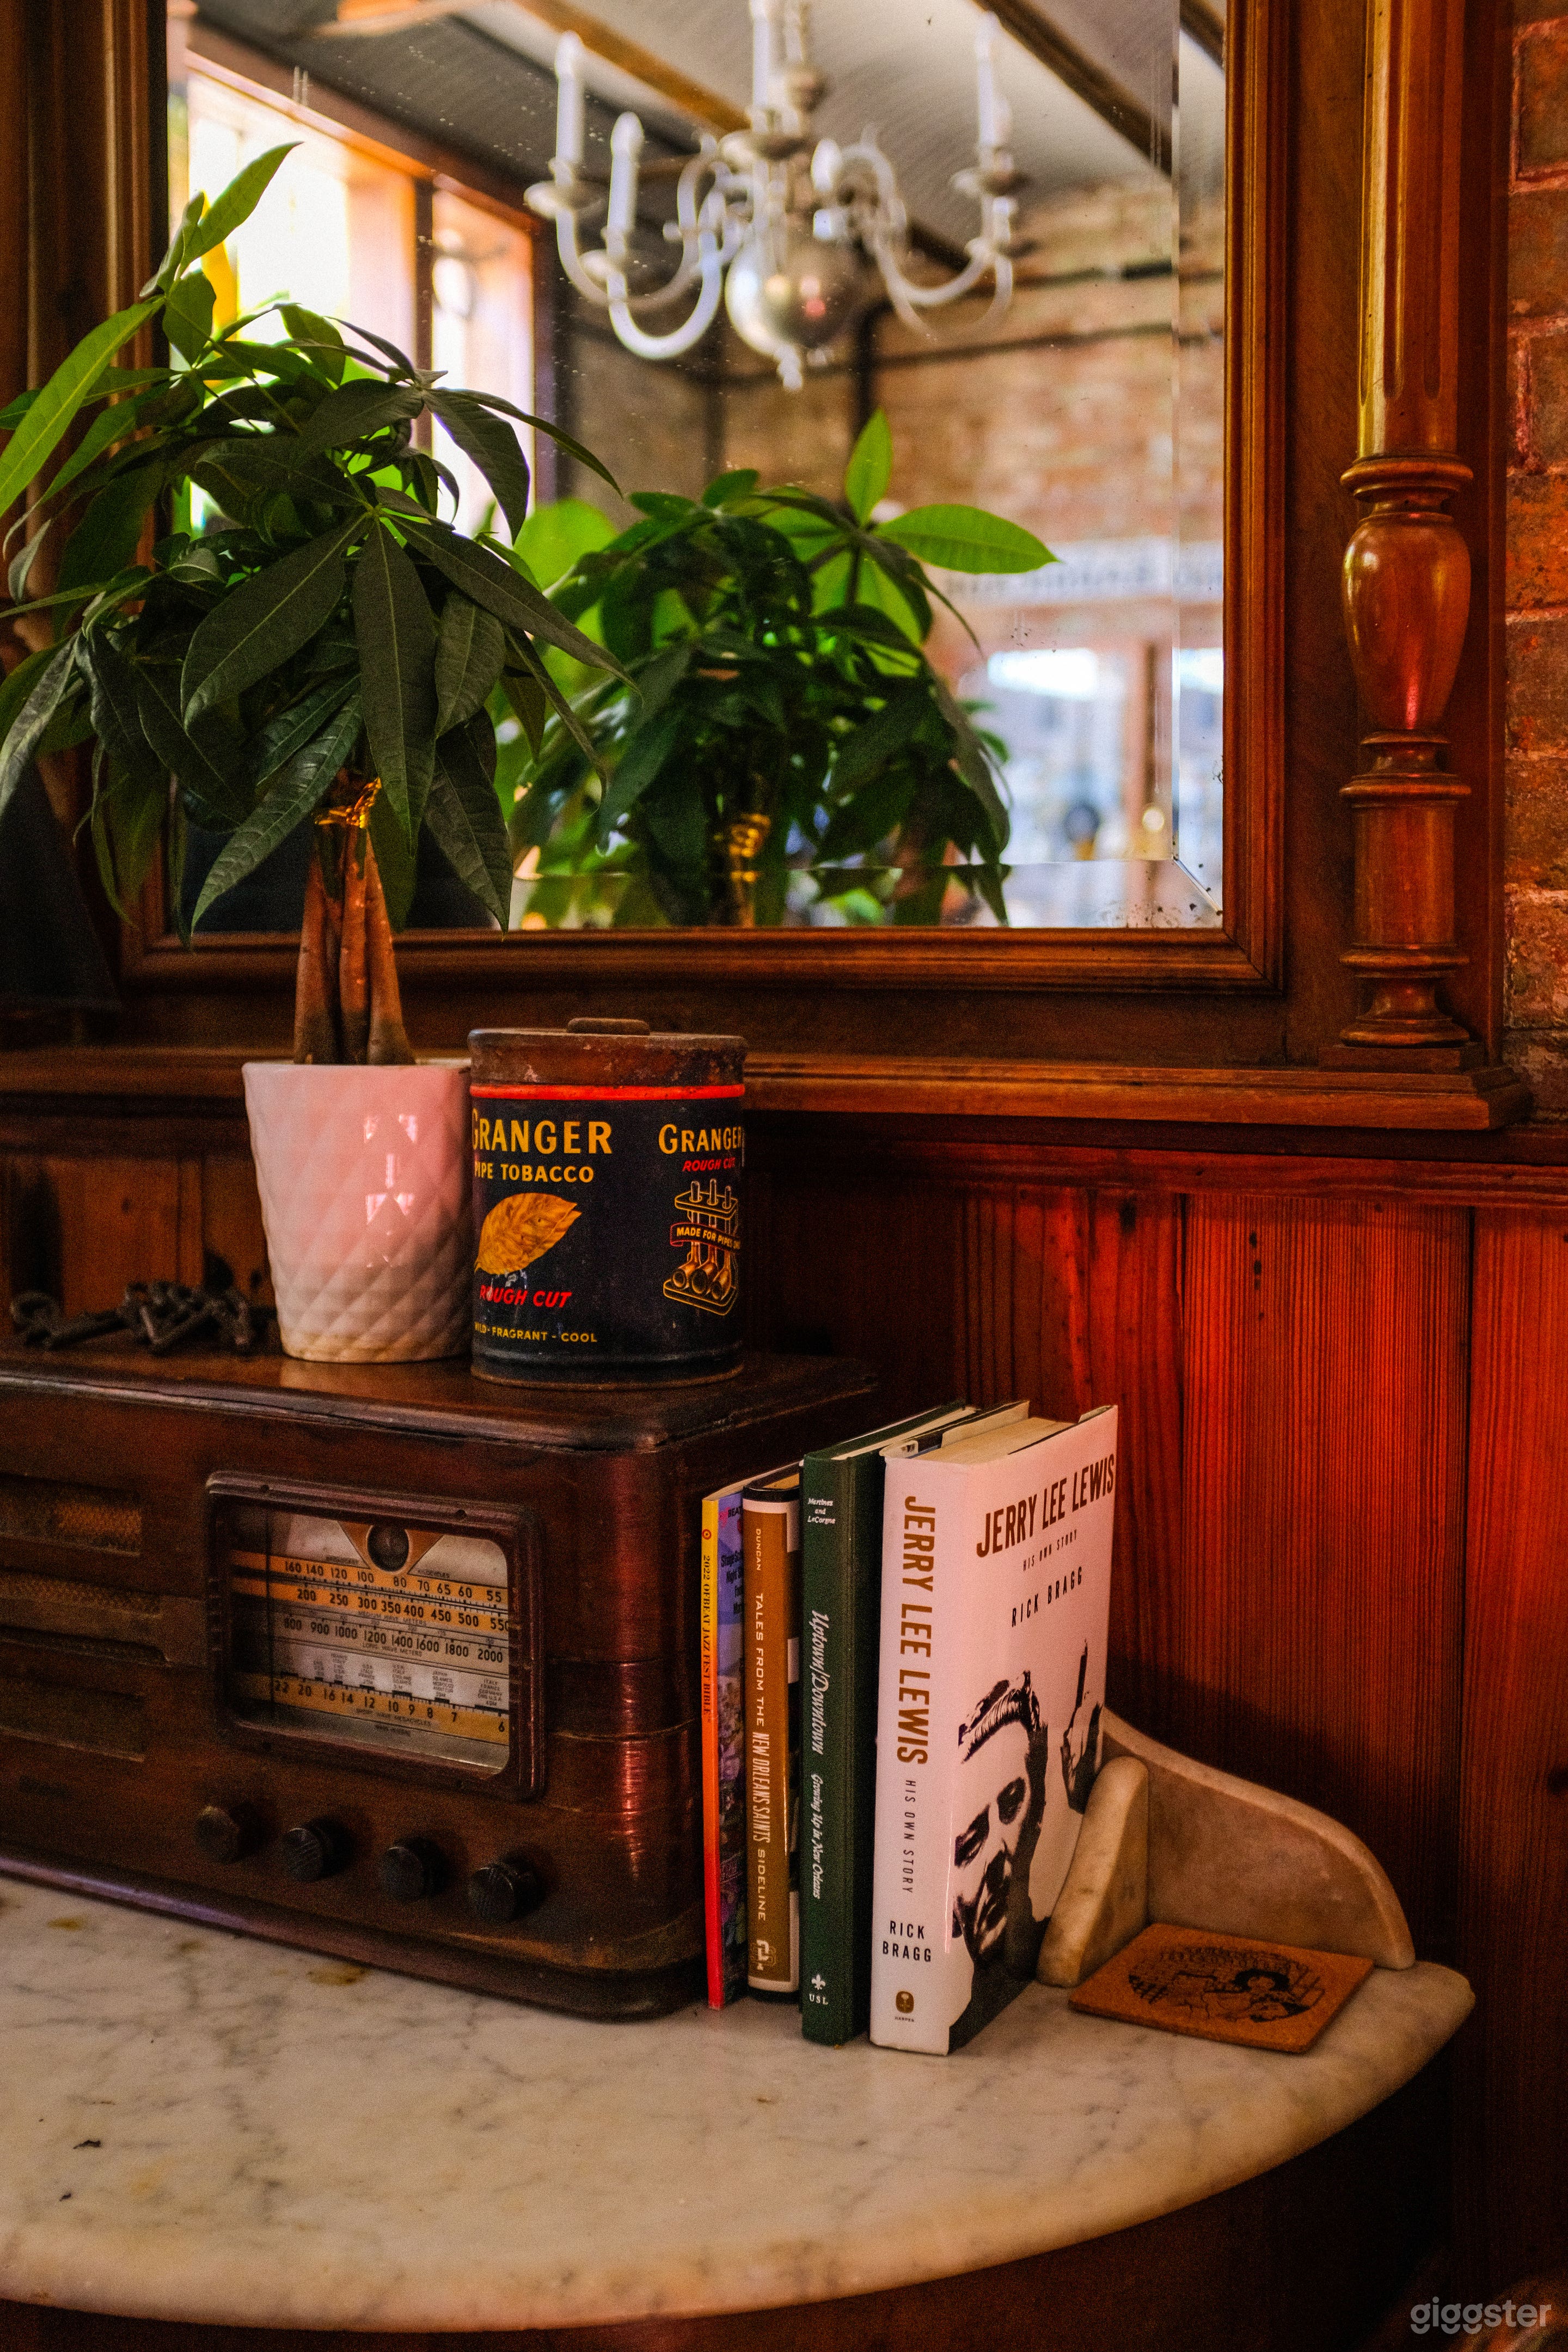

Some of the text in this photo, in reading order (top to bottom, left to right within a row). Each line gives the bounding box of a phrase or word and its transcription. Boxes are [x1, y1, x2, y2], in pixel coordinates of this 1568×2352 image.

[472, 1107, 612, 1154] GRANGER
[474, 1160, 594, 1183] PIPE TOBACCO
[682, 1157, 736, 1172] ROUGH CUT
[676, 1227, 701, 1237] MADE
[703, 1229, 716, 1241] FOR
[718, 1235, 733, 1248] PIPES
[480, 1284, 572, 1308] ROUGH CUT
[492, 1326, 547, 1341] FRAGRANT
[561, 1332, 597, 1343] COOL
[976, 1454, 1114, 1558] JERRY LEE LEWIS
[1023, 1529, 1077, 1571] HIS OWN STORY
[285, 1561, 501, 1602] 160 140 120 100 80 70 65 60 55
[1012, 1566, 1082, 1627] RICK BRAGG
[297, 1588, 316, 1601] 200
[329, 1592, 348, 1606] 250
[358, 1596, 377, 1610] 300
[381, 1600, 401, 1614] 350
[404, 1604, 424, 1618] 400
[431, 1609, 451, 1622] 450
[458, 1613, 479, 1627] 500
[310, 1621, 329, 1635] 900
[335, 1625, 358, 1640] 1000
[364, 1630, 387, 1645] 1200
[391, 1634, 413, 1649] 1400
[416, 1638, 439, 1653] 1600
[445, 1643, 469, 1657] 1800
[477, 1648, 503, 1663] 2000
[702, 1627, 710, 1651] JAZZ
[897, 1496, 935, 1765] JERRY LEE LEWIS
[399, 1648, 423, 1657] METERS
[808, 1609, 830, 1755] Uptown/Downtown
[298, 1683, 312, 1697] 20
[323, 1688, 336, 1701] 16
[342, 1692, 354, 1704] 14
[364, 1696, 376, 1708] 12
[388, 1700, 399, 1712] 10
[409, 1704, 415, 1716] 9
[427, 1707, 433, 1719] 8
[451, 1711, 458, 1723] 7
[498, 1721, 505, 1733] 6
[752, 1593, 771, 1921] TALES FROM THE NEW ORLEANS SAINTS SIDELINE
[810, 1774, 824, 1899] Growing Up in New Orleans
[902, 1780, 916, 1893] HIS OWN STORY
[890, 1920, 924, 1939] RICK
[883, 1941, 931, 1962] BRAGG
